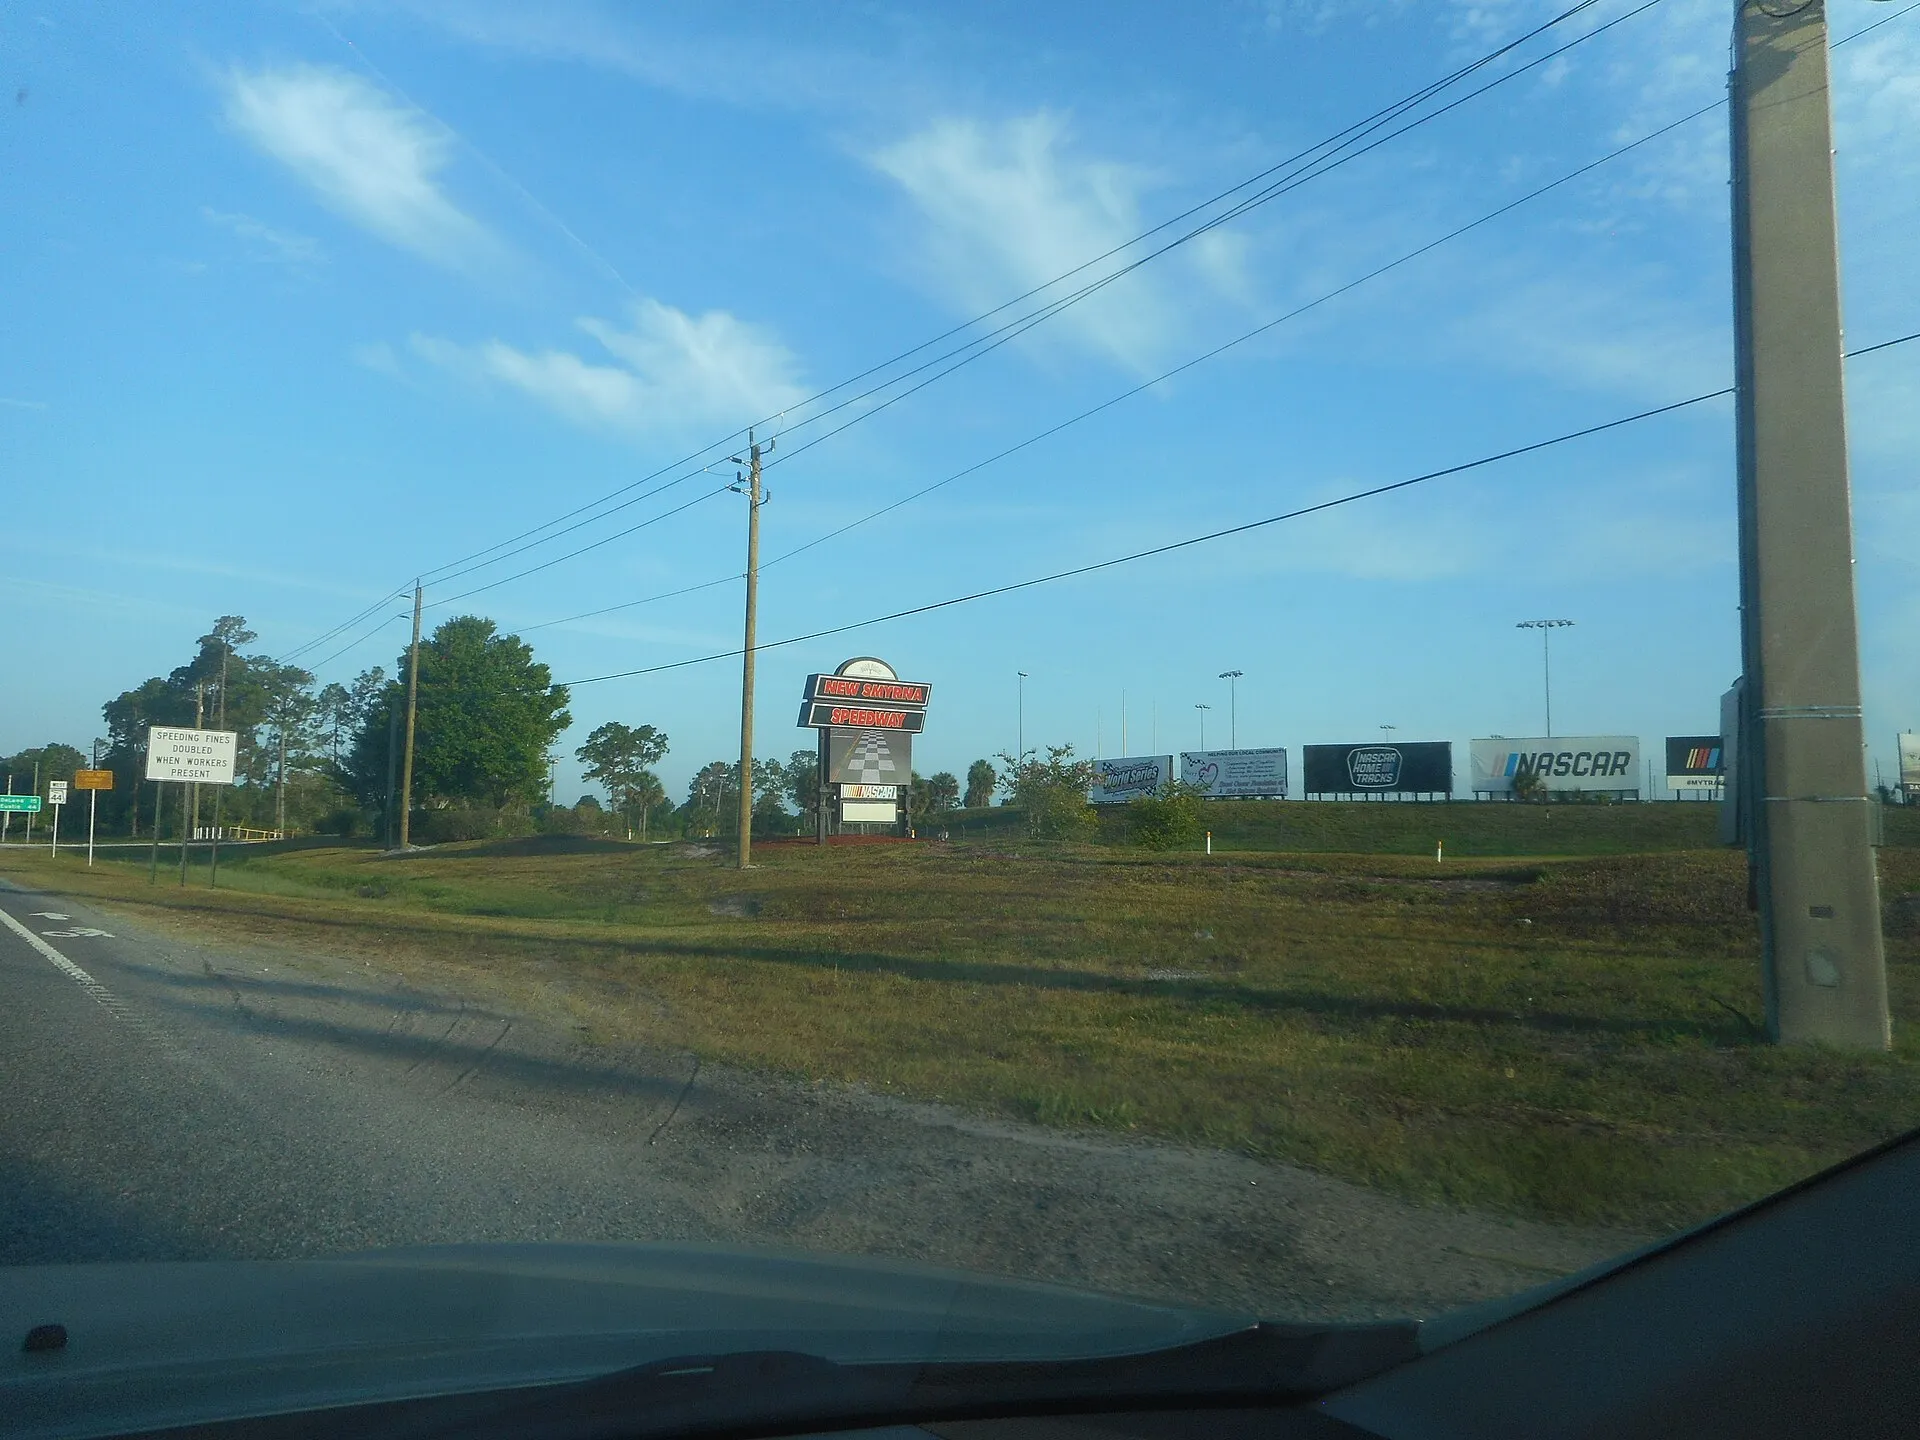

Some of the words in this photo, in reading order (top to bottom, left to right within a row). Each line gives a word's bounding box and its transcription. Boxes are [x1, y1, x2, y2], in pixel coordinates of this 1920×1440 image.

[824, 680, 860, 696] NEW
[861, 683, 923, 701] SMYRNA
[831, 708, 907, 728] SPEEDWAY
[156, 732, 200, 742] SPEEDING
[205, 735, 230, 744] FINES
[172, 744, 213, 755] DOUBLED
[156, 756, 180, 765] WHEN
[187, 758, 228, 768] WORKERS
[1356, 752, 1397, 763] NASCAR
[1516, 751, 1631, 776] NASCAR
[170, 768, 211, 778] PRESENT
[1130, 765, 1159, 783] Series
[1353, 763, 1382, 773] HOME
[1356, 773, 1394, 783] TRACKS
[861, 786, 896, 798] NASCAR
